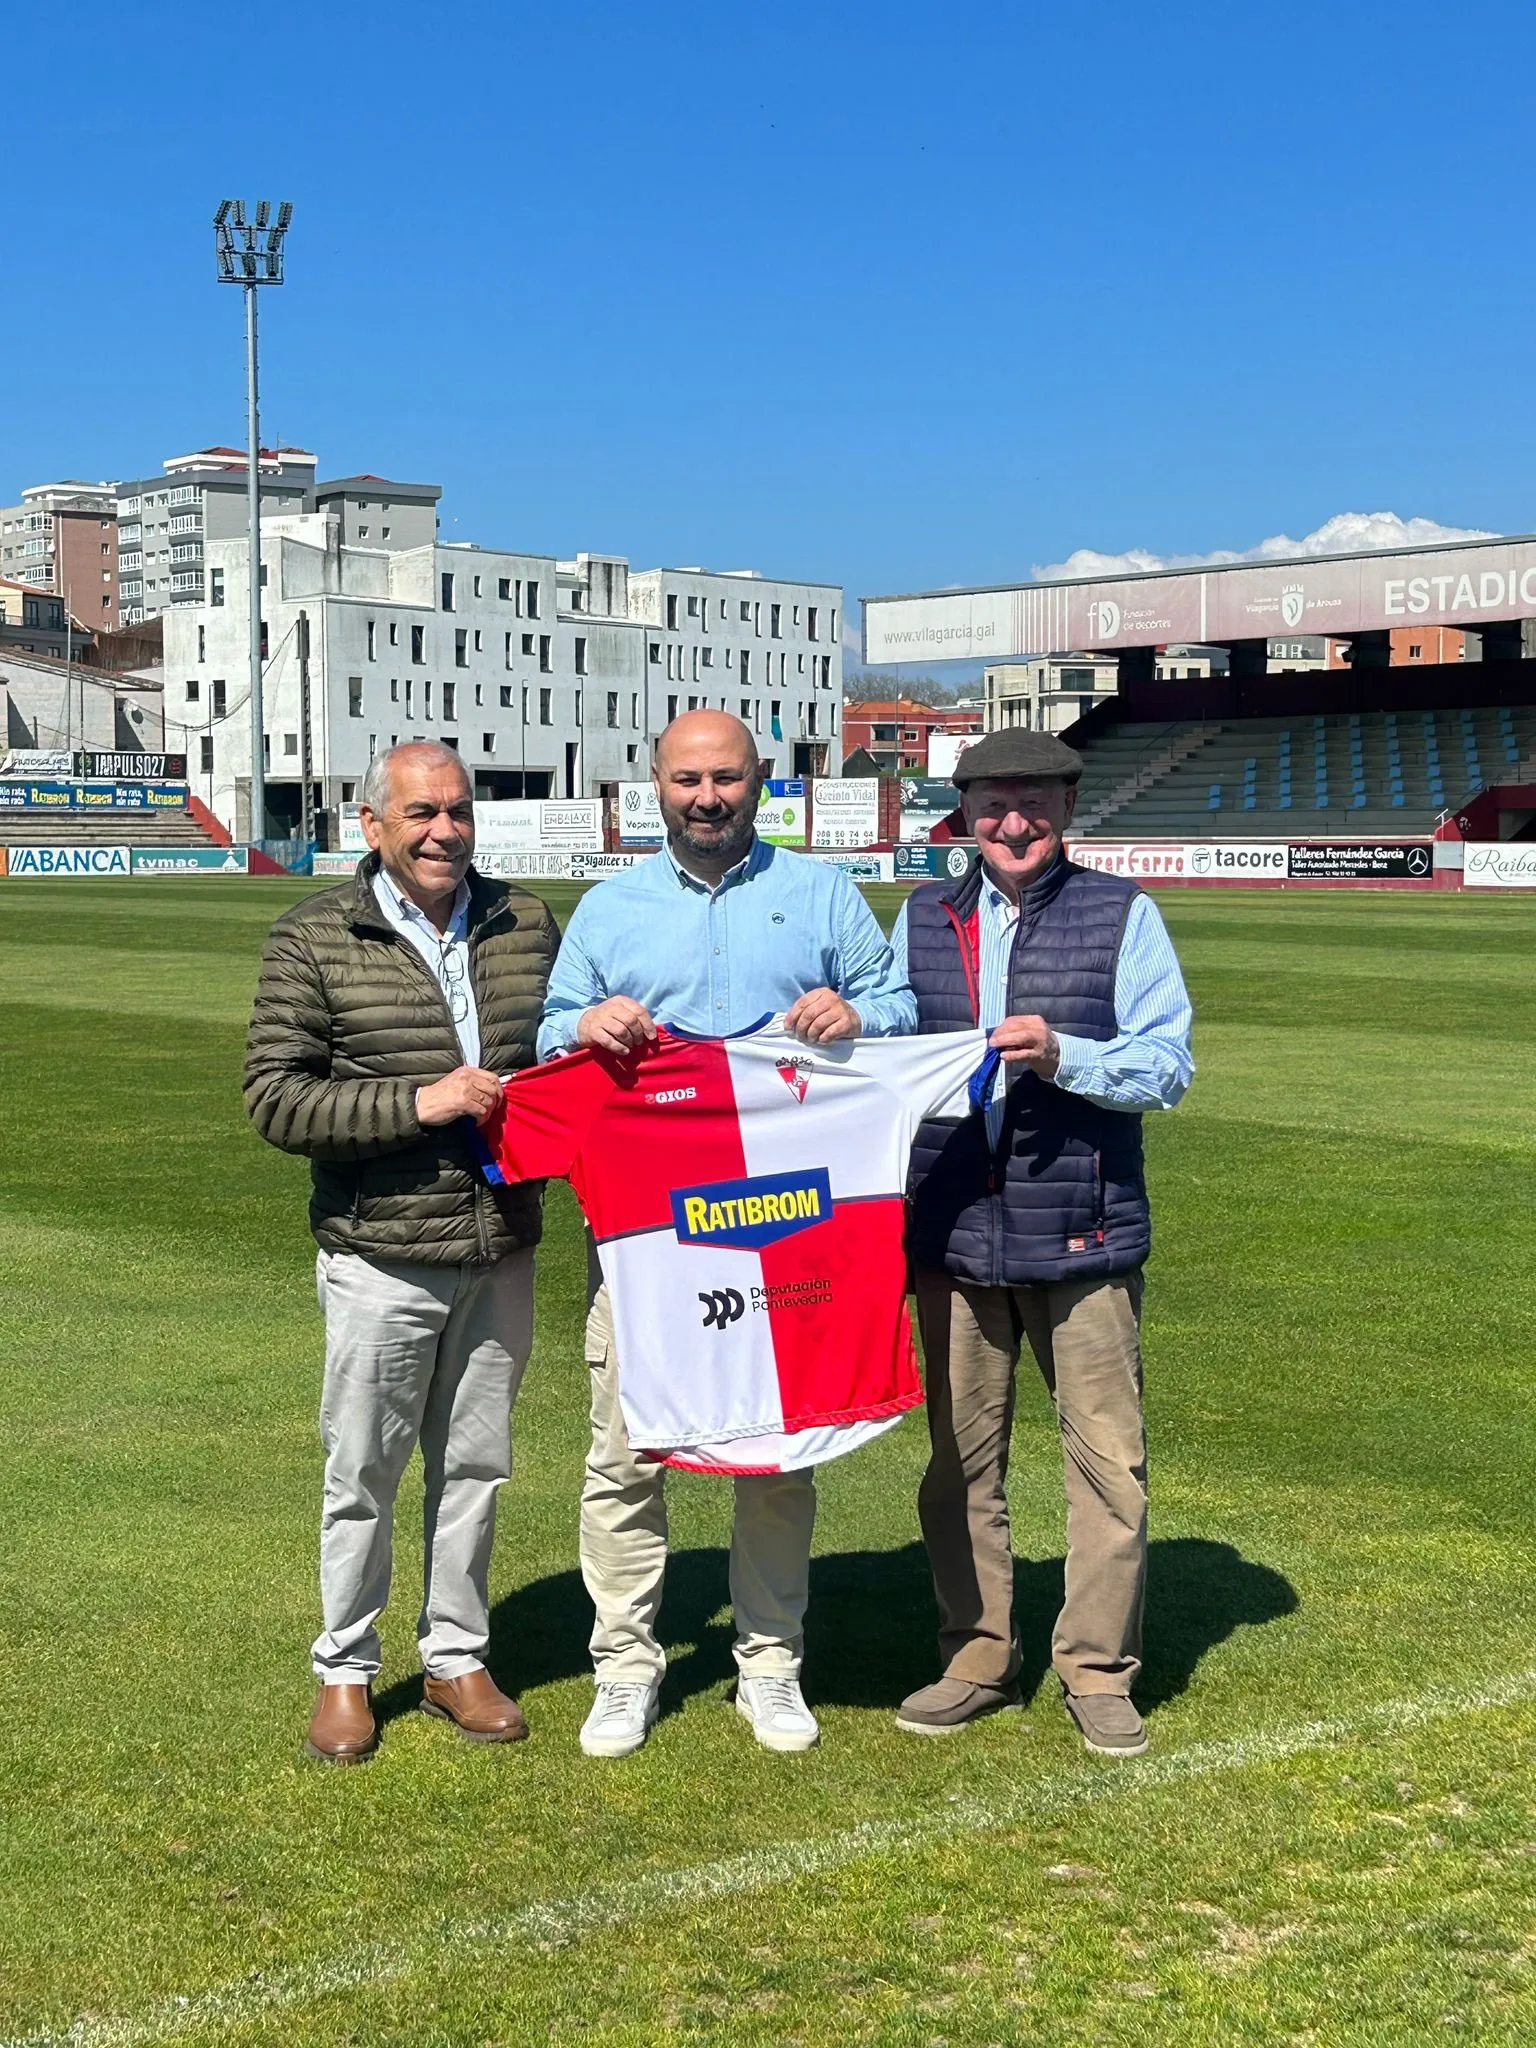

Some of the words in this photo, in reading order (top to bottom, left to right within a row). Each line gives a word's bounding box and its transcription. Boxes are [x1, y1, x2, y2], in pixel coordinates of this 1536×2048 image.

[1384, 567, 1536, 615] ESTADIO
[883, 621, 995, 644] www.vilagarcia.gal
[95, 754, 166, 776] IMPULSO27
[544, 813, 592, 825] EMBALAXE
[22, 849, 126, 873] ABANCA
[1215, 849, 1284, 868] tacore
[1290, 847, 1325, 859] Talleres
[684, 1188, 820, 1235] RATIBROM
[750, 1277, 832, 1300] Deputación
[752, 1293, 833, 1313] Pontevedra
